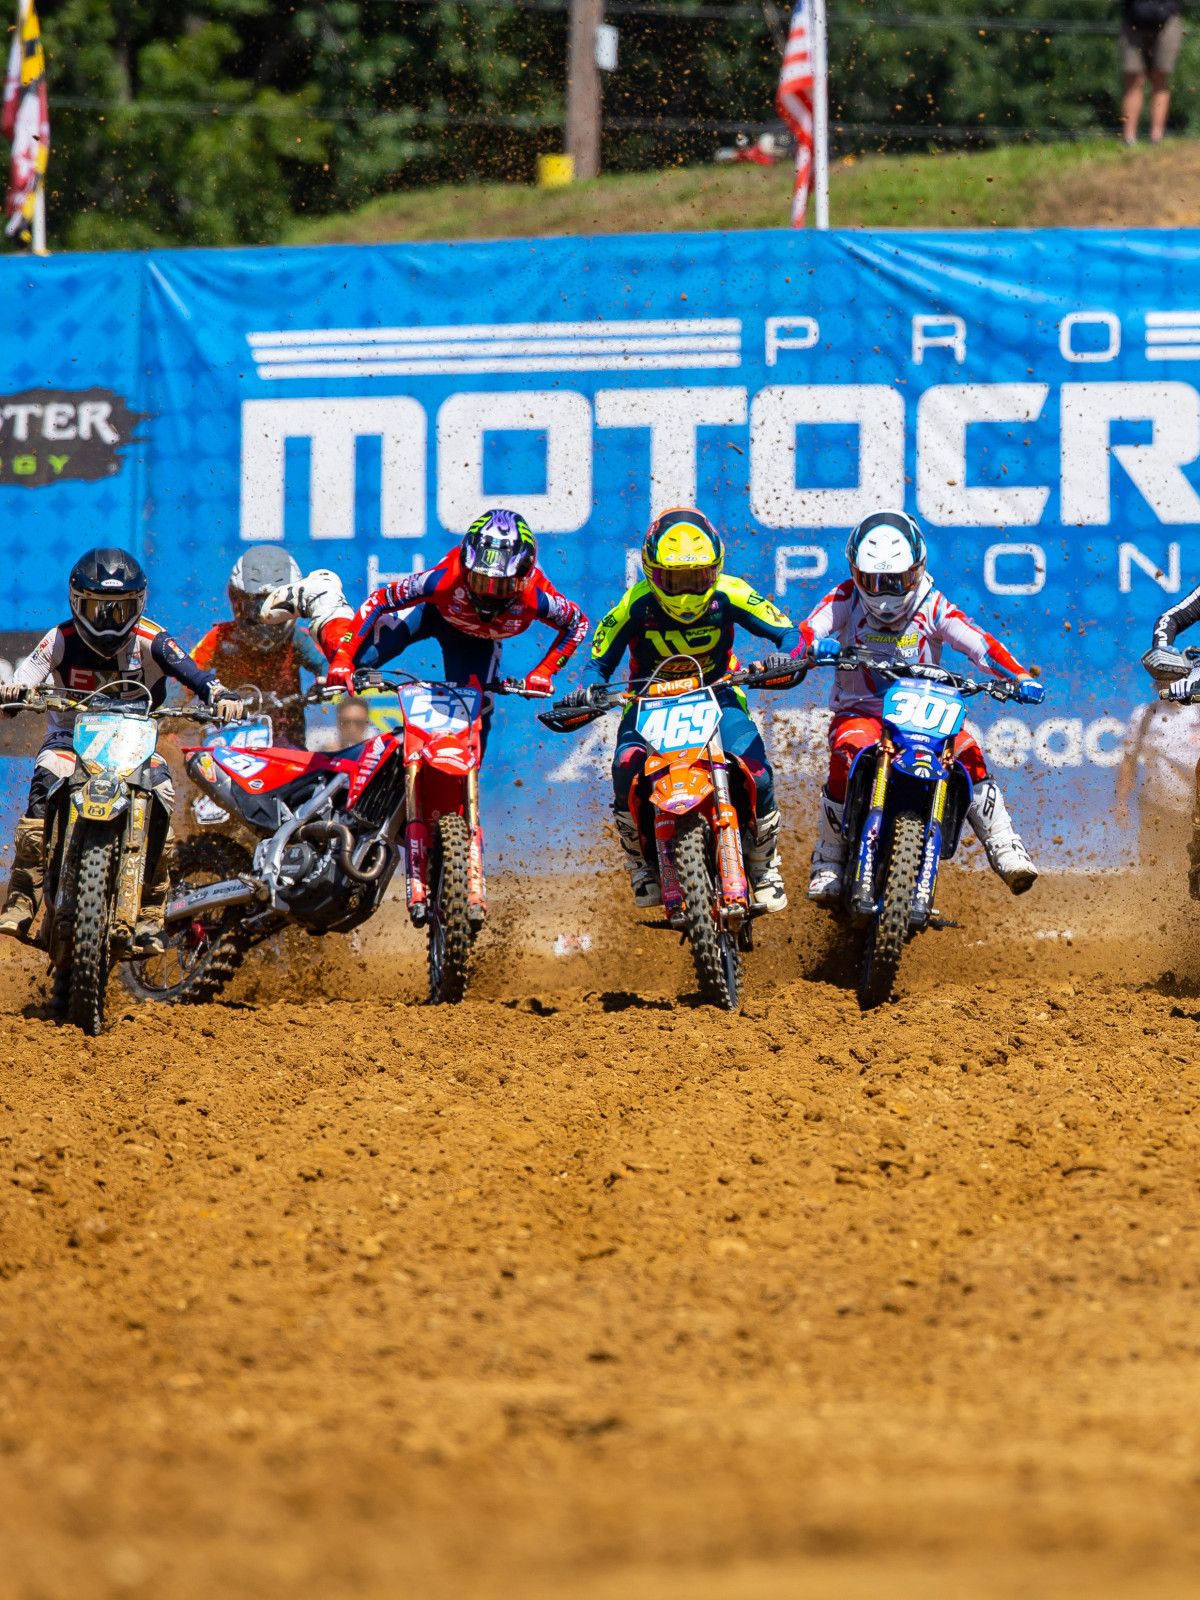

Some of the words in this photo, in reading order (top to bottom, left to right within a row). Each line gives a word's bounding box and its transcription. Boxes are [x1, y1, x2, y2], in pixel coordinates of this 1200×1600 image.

[765, 312, 1121, 366] PRO
[0, 400, 120, 445] TER
[0, 453, 70, 475] GY
[71, 669, 145, 692] FXR
[765, 675, 792, 686] CIRCUIT
[838, 663, 857, 671] ASV
[990, 689, 1008, 700] ASV
[410, 695, 475, 730] 51
[641, 701, 717, 752] 469
[884, 690, 962, 736] 301
[410, 837, 423, 894] DULOP
[915, 836, 938, 904] Hoosier
[212, 883, 249, 896] DUNLO
